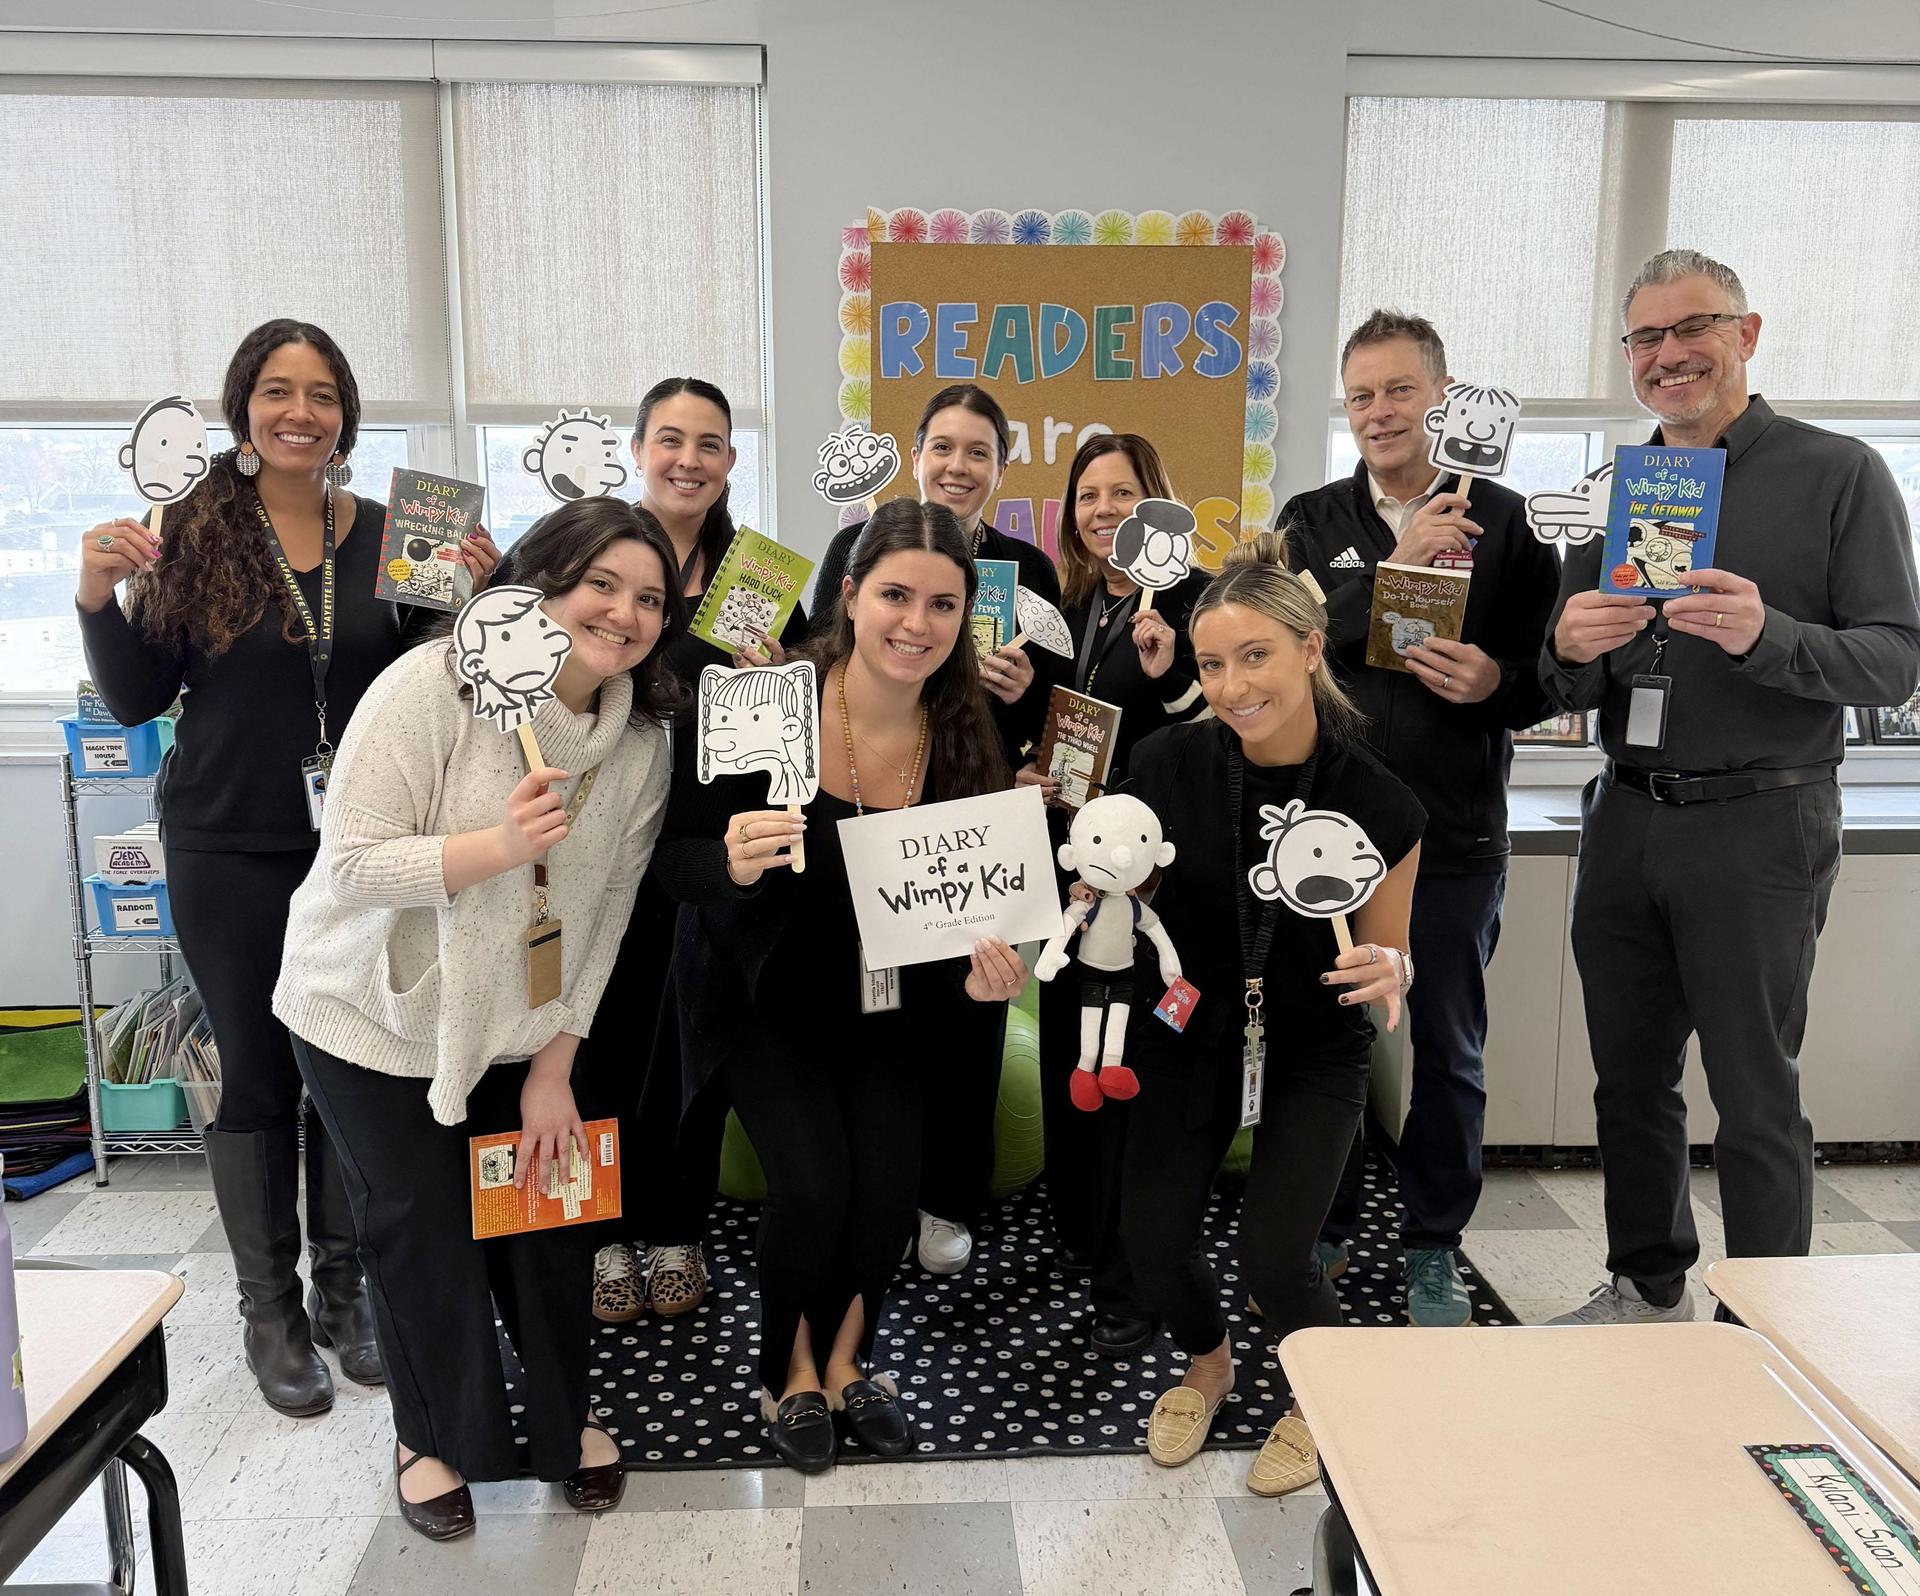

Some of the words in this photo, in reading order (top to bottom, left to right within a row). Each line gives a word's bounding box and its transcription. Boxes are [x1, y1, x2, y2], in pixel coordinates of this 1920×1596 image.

[880, 301, 1243, 384] READERS
[1644, 455, 1694, 468] DIARY
[1655, 468, 1668, 480] of
[416, 480, 460, 498] DIARY
[1625, 478, 1678, 501] Wimpy
[1678, 478, 1706, 499] Kid
[426, 495, 438, 506] of
[1629, 501, 1648, 516] THE
[1651, 503, 1703, 519] GETAWAY
[400, 499, 445, 523] Wimpy
[446, 506, 468, 526] Kid
[395, 519, 445, 537] WRECKING
[757, 540, 796, 566] DIARY
[1330, 559, 1365, 568] adidas
[740, 552, 776, 583] Wimpy
[775, 571, 797, 592] Kid
[739, 573, 761, 590] HARD
[761, 584, 784, 602] LUCK
[987, 585, 1007, 602] Kid
[1377, 578, 1390, 586] The
[1388, 575, 1438, 595] Wimpy
[1438, 580, 1465, 597] Kid
[277, 557, 306, 607] LAFAYETTE
[302, 610, 318, 641] LIONS
[978, 604, 1001, 614] FEVER
[1383, 591, 1456, 607] Do-It-Yourself
[1410, 601, 1429, 609] Book
[322, 588, 332, 640] LAFAYETTE
[1068, 698, 1101, 717] DIARY
[1056, 712, 1088, 738] Wimpy
[1087, 722, 1105, 743] Kid
[1057, 731, 1067, 741] THE
[1067, 735, 1083, 747] THIRD
[1082, 741, 1099, 753] WHEEL
[899, 825, 991, 860] DIARY
[115, 851, 139, 860] JEDI
[927, 856, 948, 877] of
[957, 862, 969, 874] a
[877, 880, 974, 914] Wimpy
[979, 863, 1025, 899] Kid
[935, 918, 962, 930] Grade
[964, 912, 996, 925] Edition
[1805, 1474, 1870, 1517] Kylani
